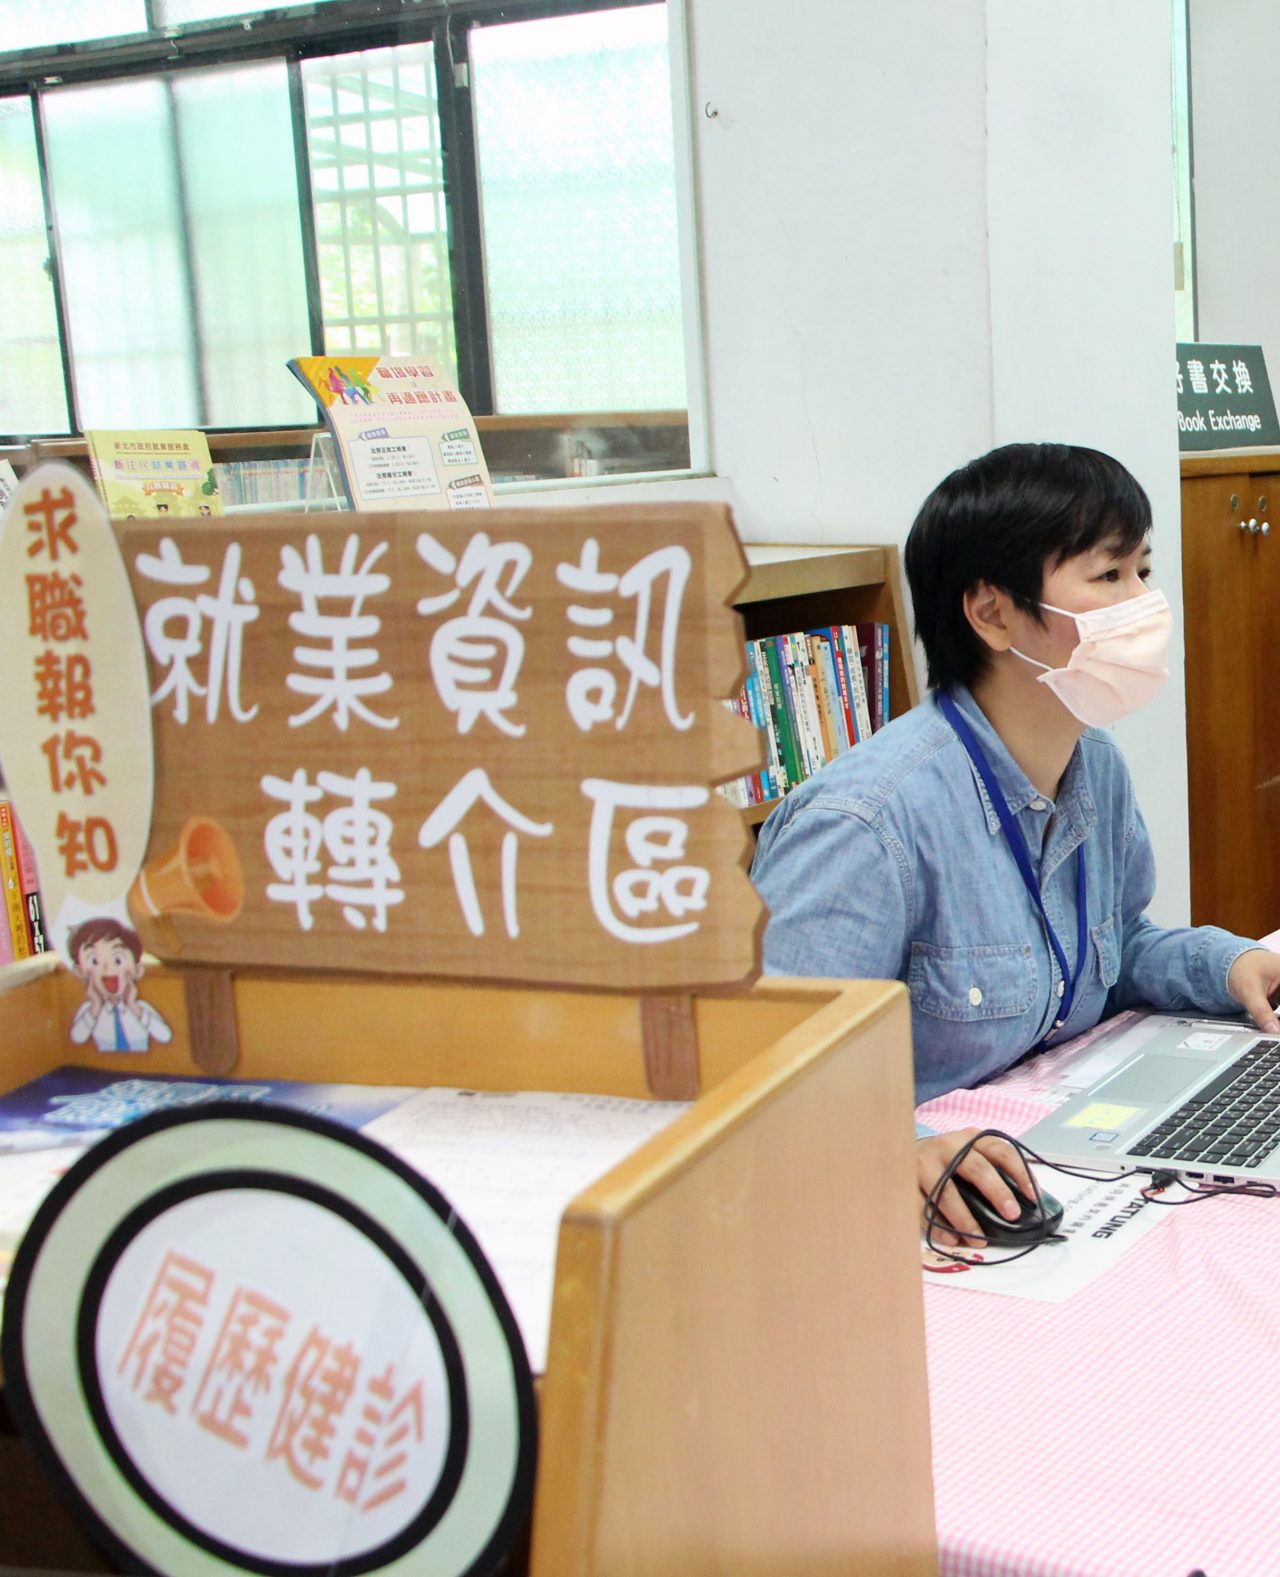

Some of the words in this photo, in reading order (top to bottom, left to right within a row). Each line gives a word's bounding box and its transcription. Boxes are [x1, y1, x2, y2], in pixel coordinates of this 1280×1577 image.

[1177, 409, 1208, 432] Book
[1208, 409, 1262, 432] Exchange
[23, 487, 118, 880] 求職報你知
[135, 531, 694, 736] 就業資訊
[260, 767, 710, 944] 轉介區
[117, 1248, 425, 1514] 履歷健診
